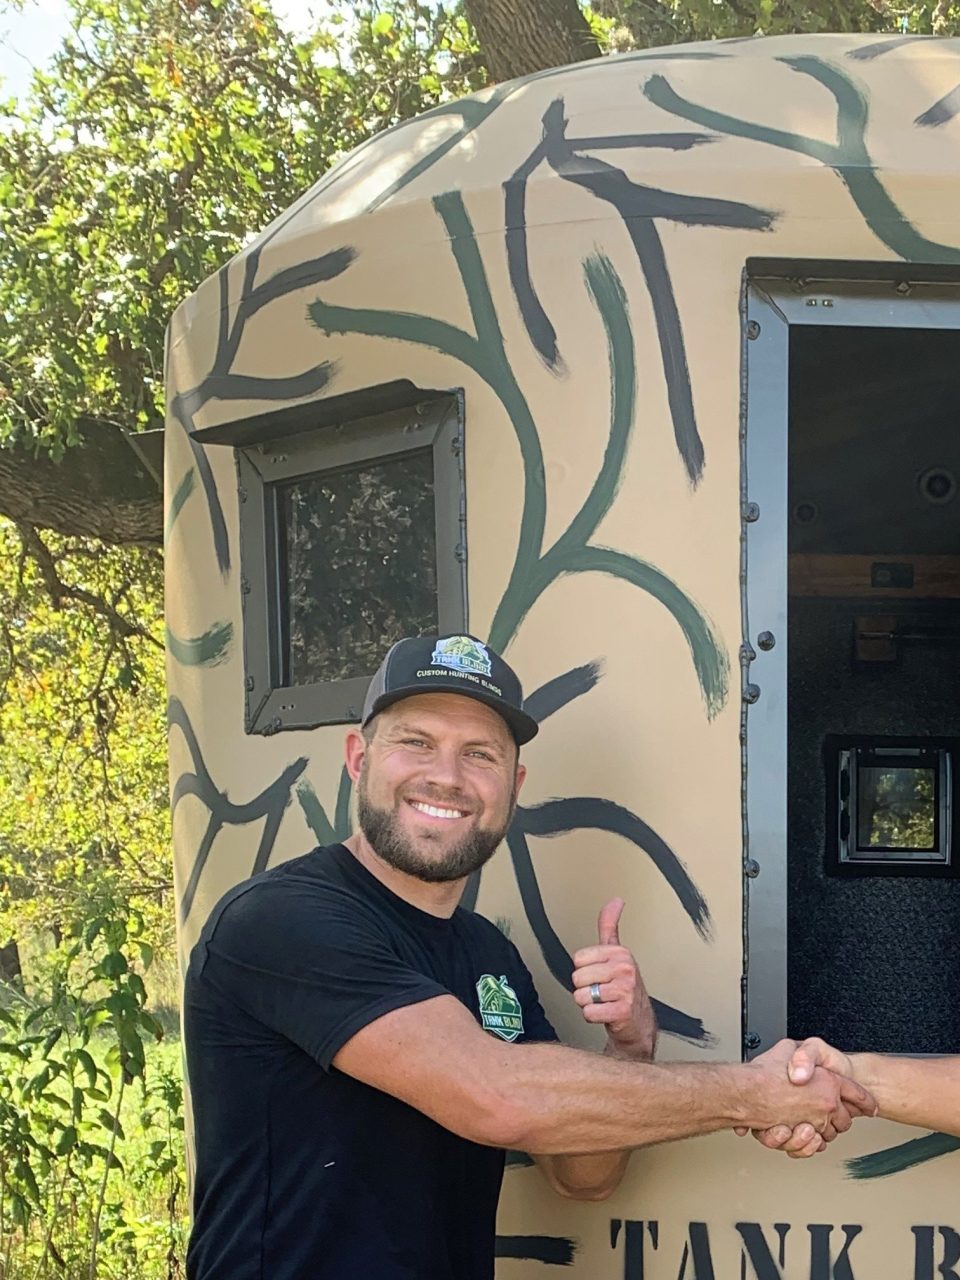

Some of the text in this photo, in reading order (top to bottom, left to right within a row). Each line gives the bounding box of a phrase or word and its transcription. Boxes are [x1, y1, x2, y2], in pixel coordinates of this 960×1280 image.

[416, 670, 502, 697] CUSTOM HUNTING BLINDS
